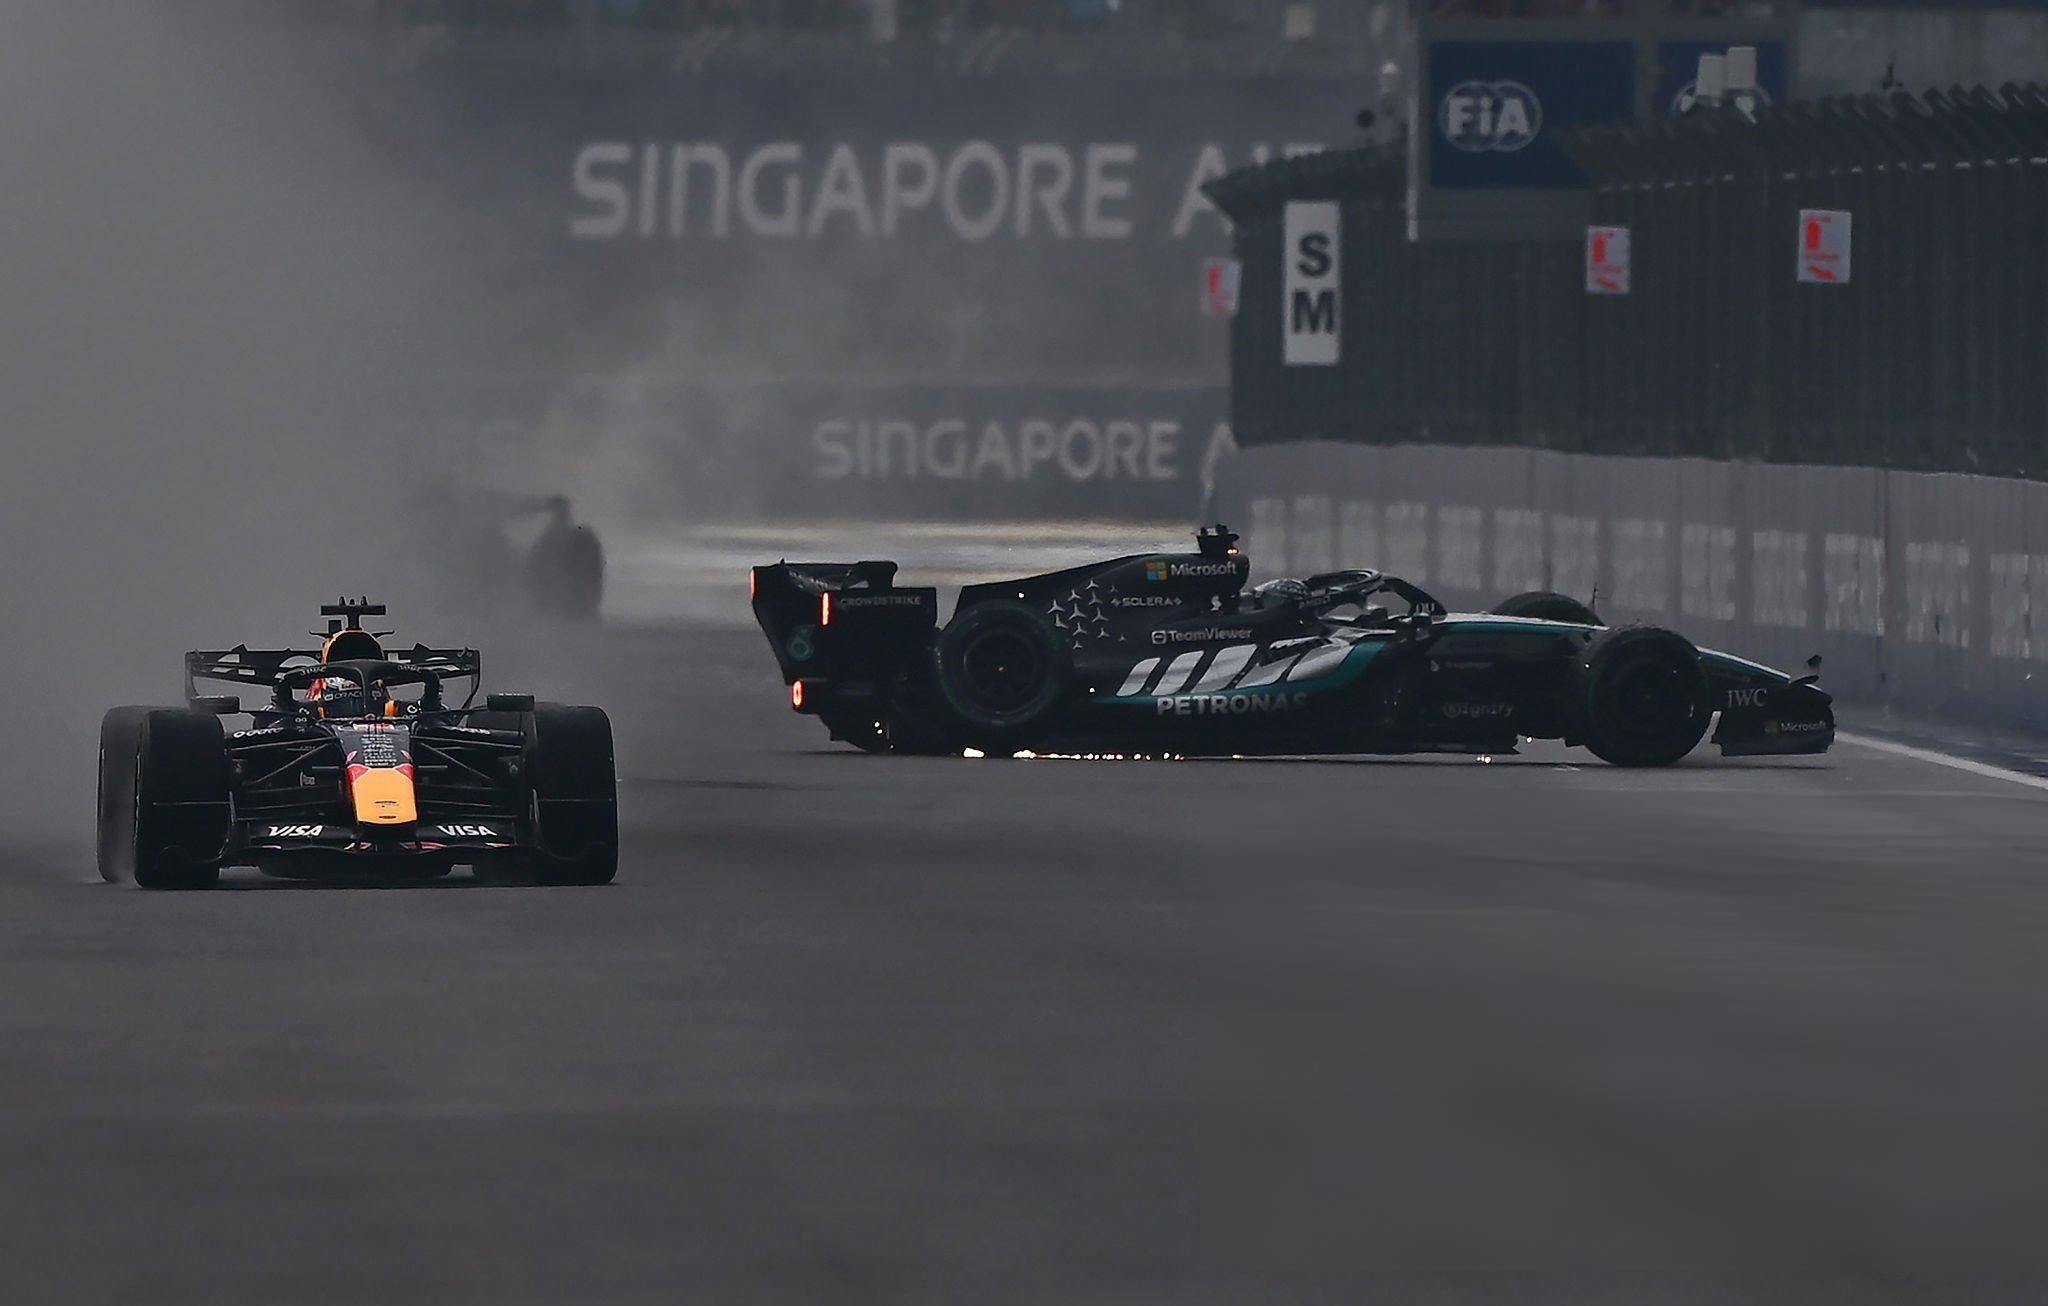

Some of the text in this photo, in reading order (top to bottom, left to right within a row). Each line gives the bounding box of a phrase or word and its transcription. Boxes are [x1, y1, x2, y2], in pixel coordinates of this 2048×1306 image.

[570, 141, 1139, 239] SINGAPORE
[813, 419, 1182, 480] SINGAPORE
[1170, 560, 1237, 577] Microsoft
[1121, 597, 1173, 608] SOLERA
[1167, 627, 1253, 642] TeamViewer
[1157, 693, 1306, 716] PETRONAS
[1727, 687, 1768, 708] IWC
[1780, 720, 1828, 732] Microsoft
[267, 824, 325, 837] VISA
[437, 824, 498, 837] VISA
